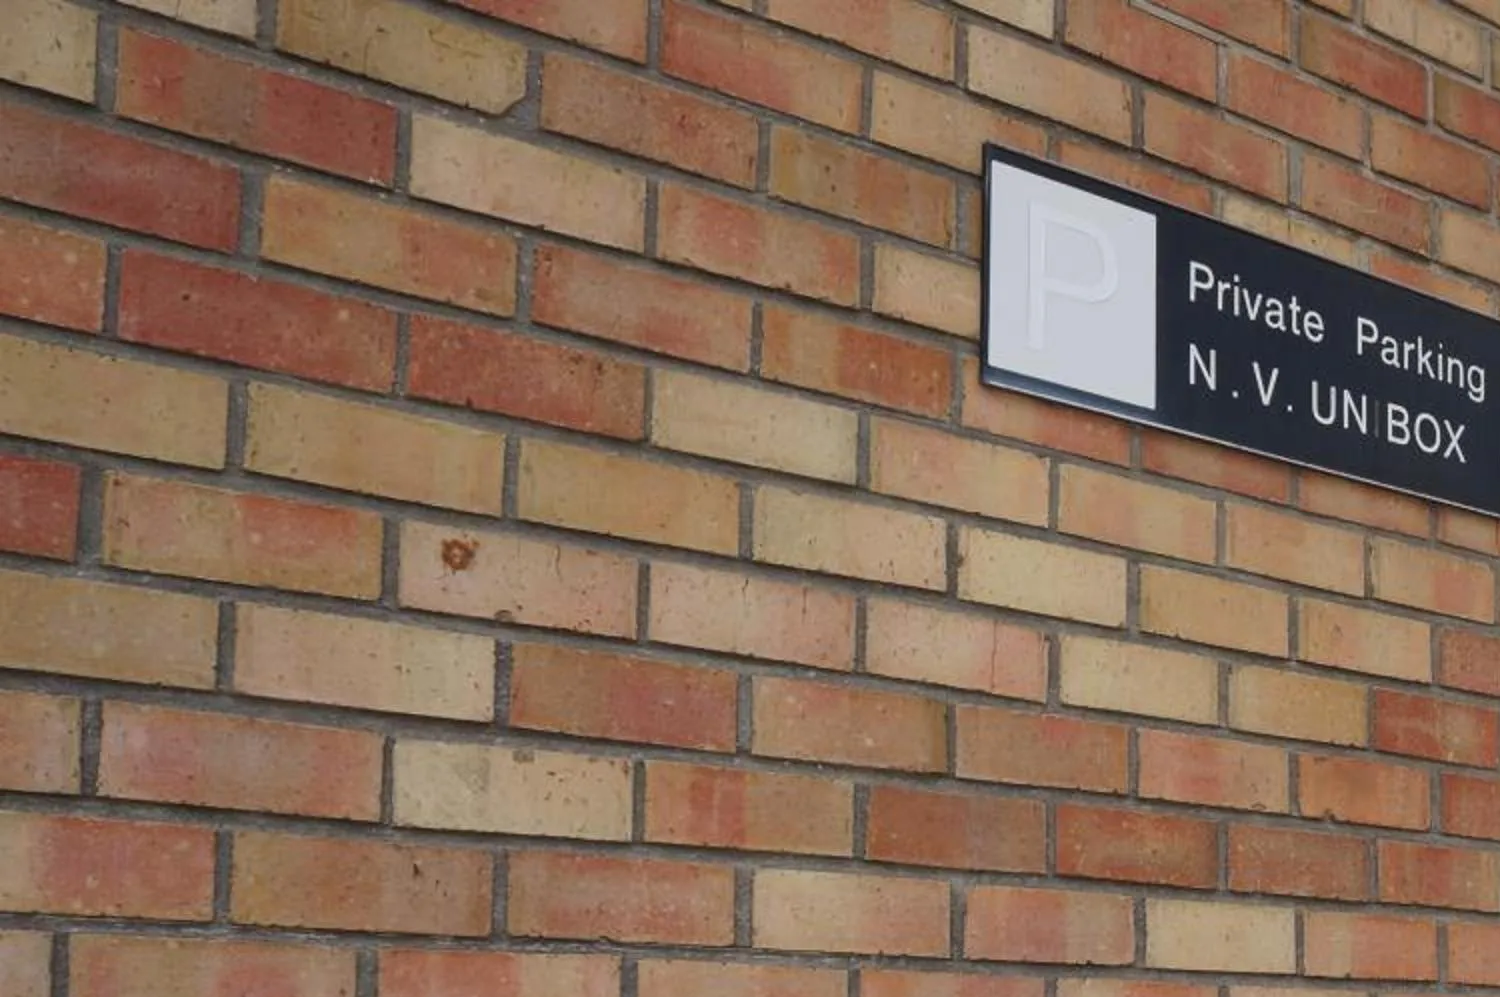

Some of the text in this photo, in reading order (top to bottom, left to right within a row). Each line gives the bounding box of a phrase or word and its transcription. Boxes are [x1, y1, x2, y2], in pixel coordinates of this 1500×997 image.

[1027, 200, 1118, 350] P
[1189, 260, 1485, 403] Private Parking
